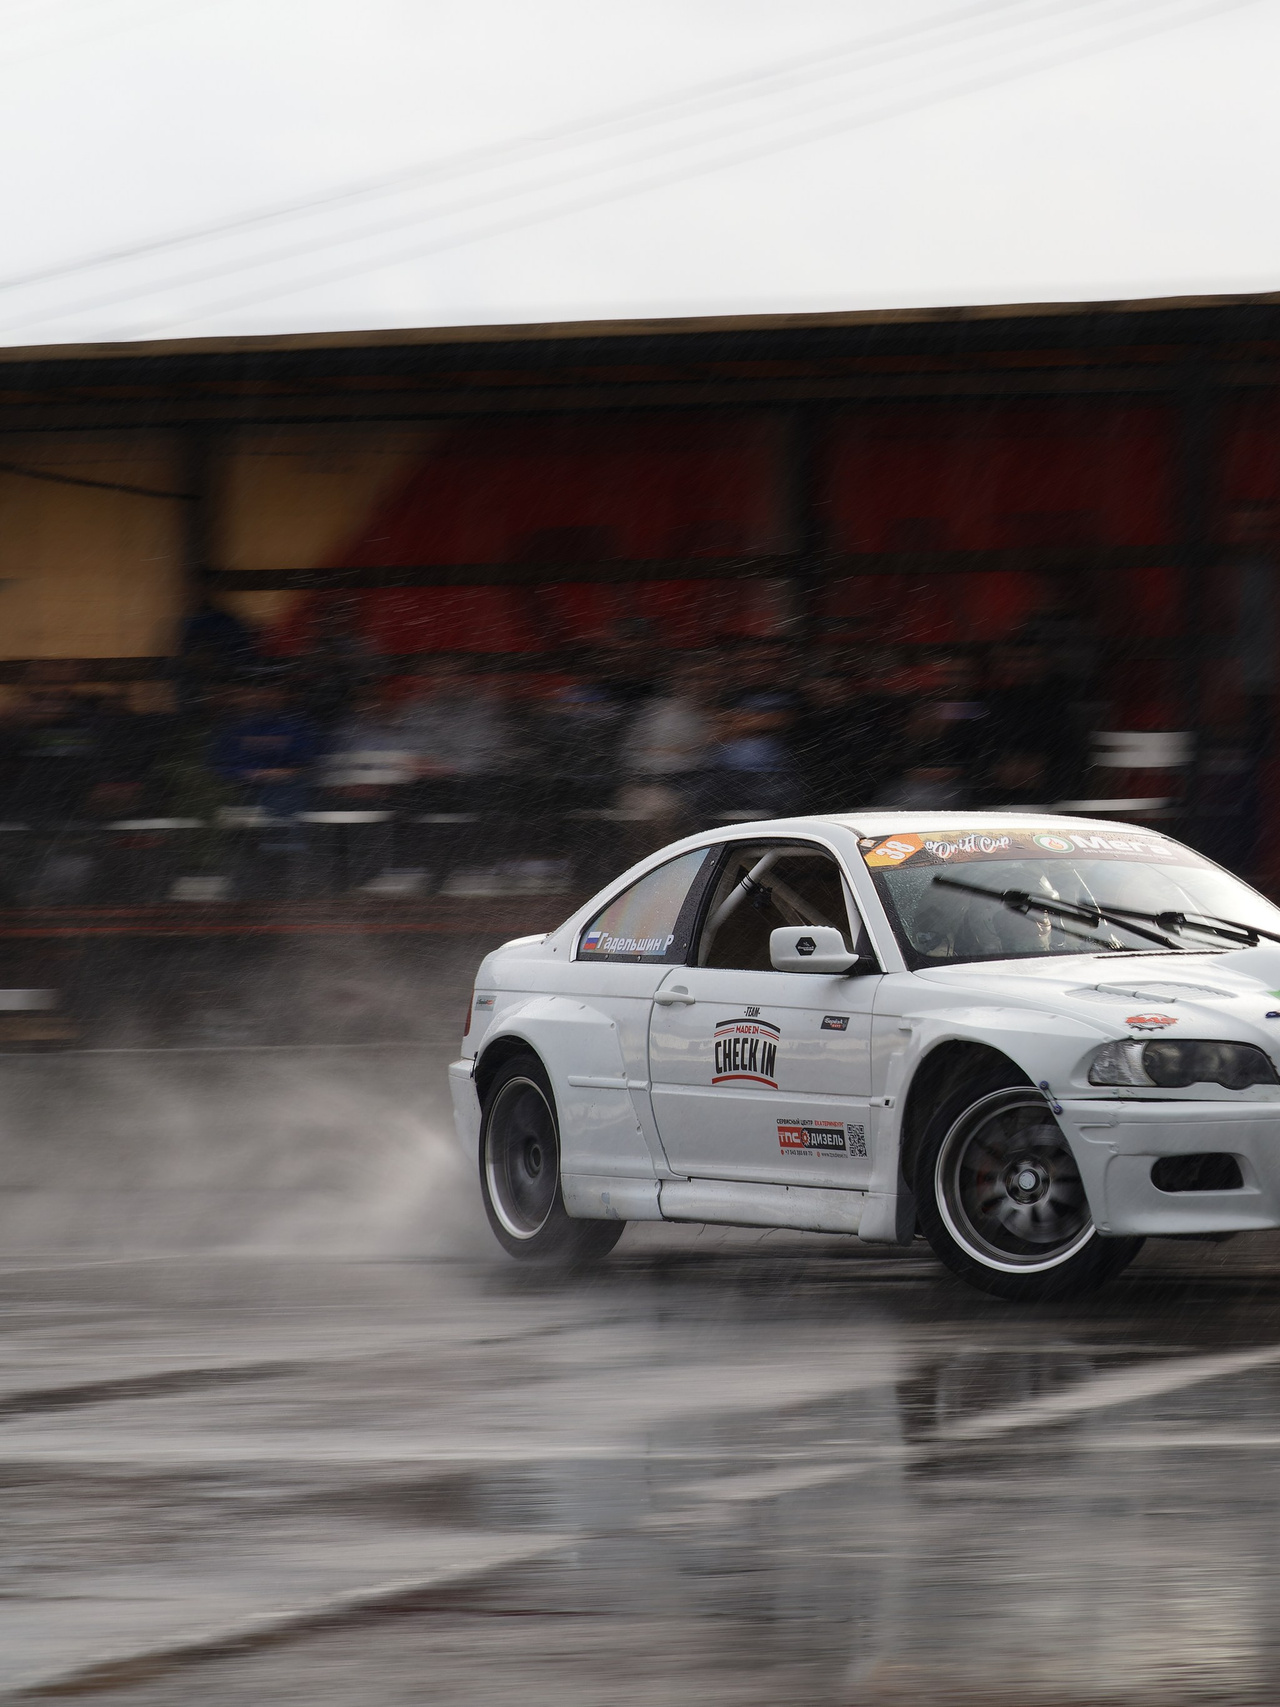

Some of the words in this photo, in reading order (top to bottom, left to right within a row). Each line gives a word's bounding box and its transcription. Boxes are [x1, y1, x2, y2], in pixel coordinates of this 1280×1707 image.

[875, 840, 916, 860] 38
[597, 932, 662, 953] Гадельшин
[663, 934, 675, 951] Р
[735, 1025, 751, 1034] MADE
[752, 1026, 760, 1035] IN
[714, 1037, 759, 1075] CHECK
[760, 1040, 777, 1079] IN
[811, 1132, 844, 1147] ДИЗЕЛЬ
